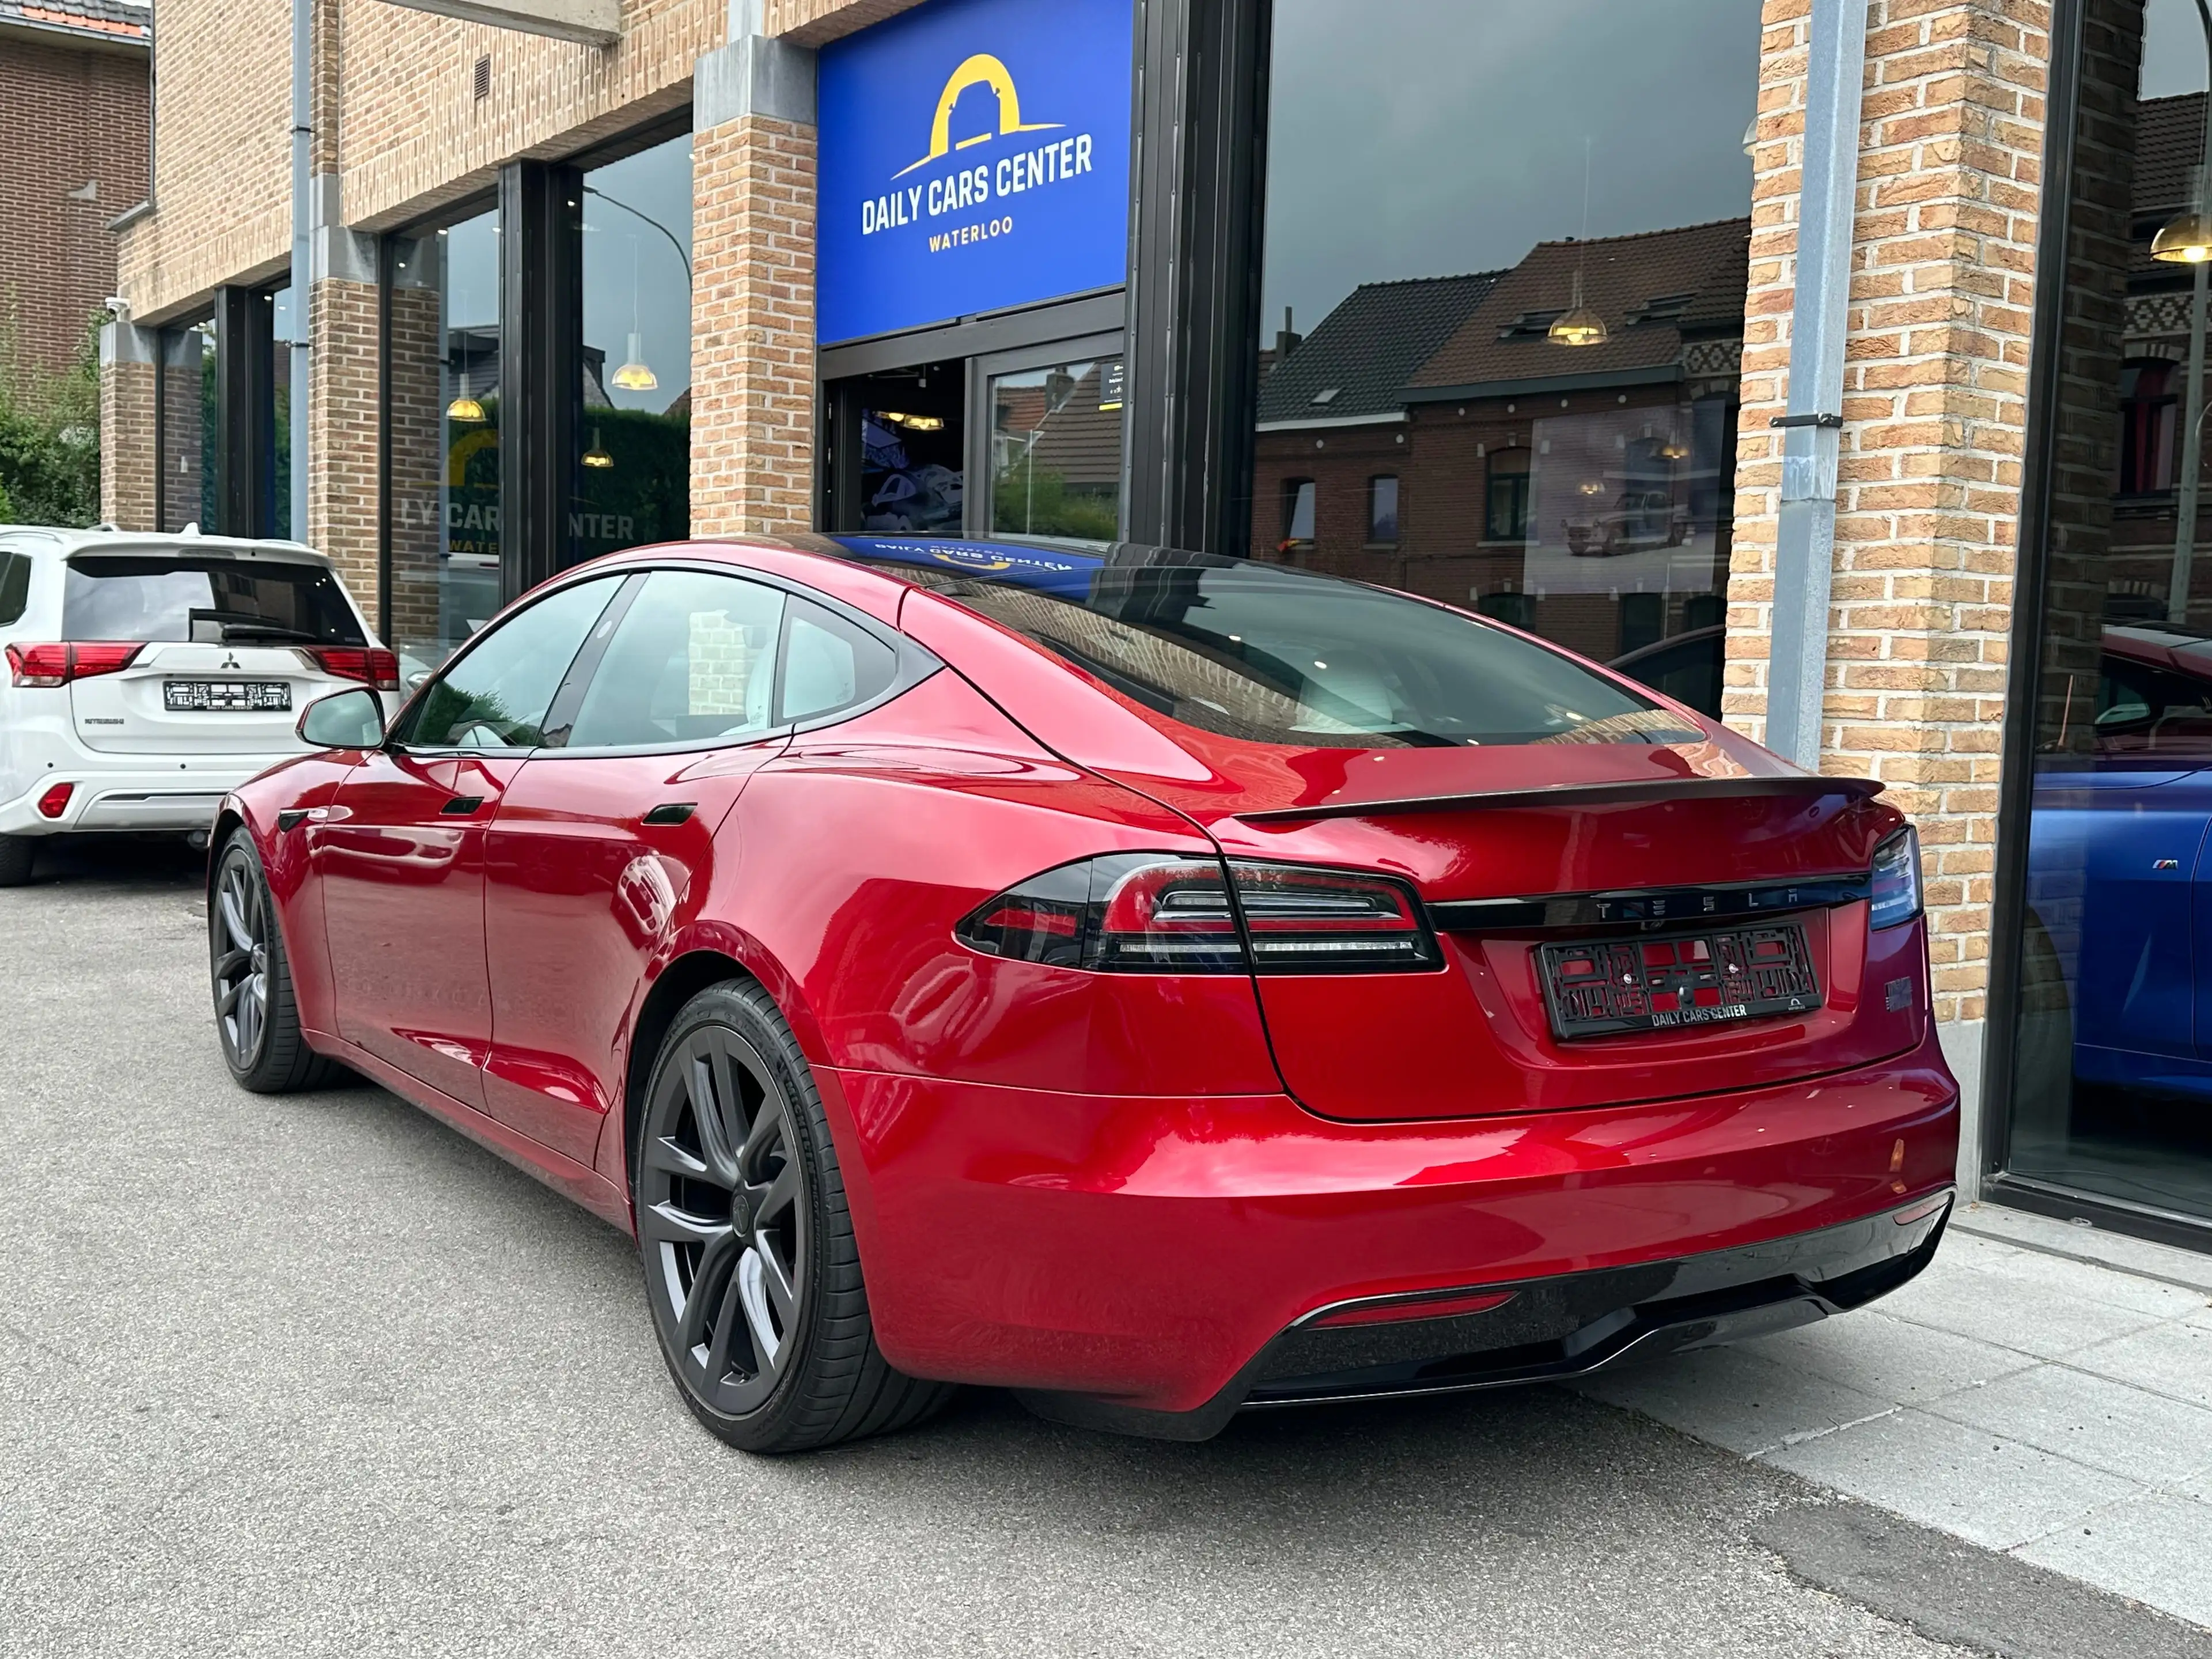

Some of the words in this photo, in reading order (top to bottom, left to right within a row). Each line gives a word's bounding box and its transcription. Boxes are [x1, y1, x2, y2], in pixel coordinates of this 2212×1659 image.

[862, 185, 922, 235] DAILY
[928, 165, 988, 216] CARS
[995, 134, 1092, 197] CENTER
[929, 216, 1013, 252] WATERLOO
[446, 503, 499, 532] CAR
[569, 512, 634, 540] NTER
[447, 539, 498, 554] WATE
[1596, 888, 1798, 919] TESLA
[1652, 1014, 1681, 1027] DAILY
[1683, 1009, 1710, 1023] CARS
[1711, 1004, 1747, 1020] CENTER
